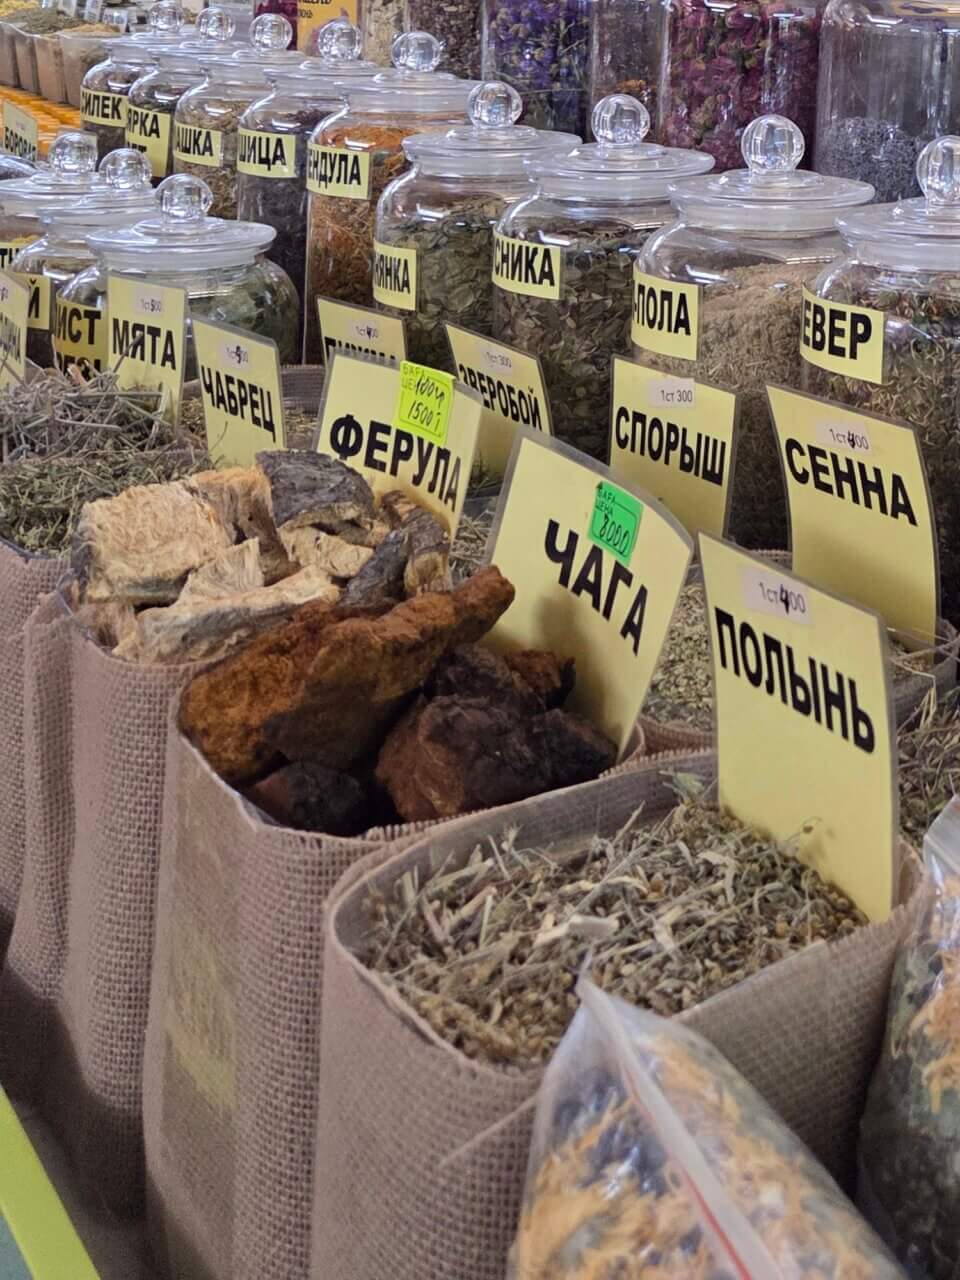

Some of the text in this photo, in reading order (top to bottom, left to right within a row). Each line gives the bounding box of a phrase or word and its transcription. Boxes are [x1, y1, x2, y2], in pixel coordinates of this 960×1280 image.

[112, 318, 176, 371] МЯТА
[201, 364, 276, 443] ЧАБРЕЦ
[660, 389, 693, 403] 1ст 300
[330, 414, 461, 513] ФЕРУЛА
[615, 406, 726, 487] СПОРЫШ
[829, 428, 846, 445] 1ст
[785, 437, 918, 527] СЕННА
[544, 519, 648, 657] ЧАГА
[758, 581, 778, 605] 1ст
[715, 606, 875, 754] ПОЛЫНЬ
